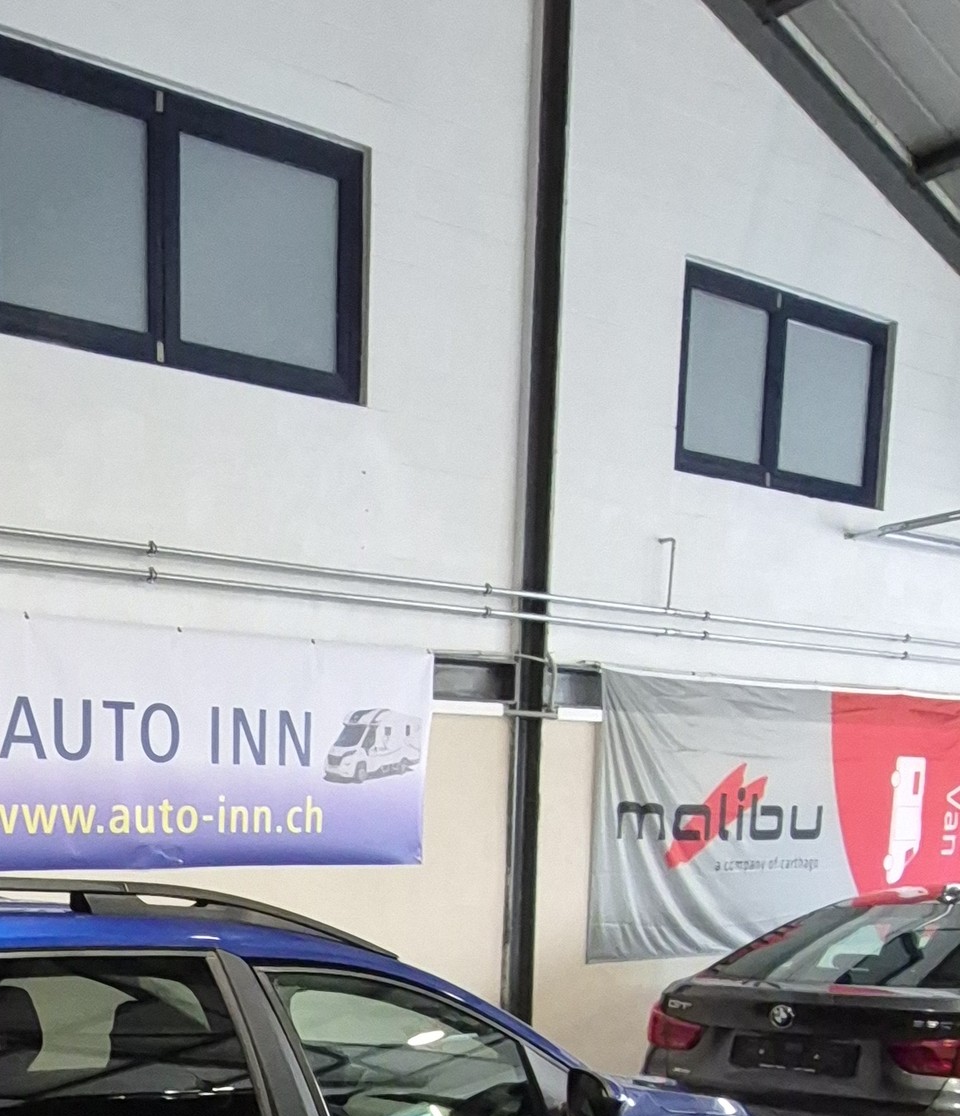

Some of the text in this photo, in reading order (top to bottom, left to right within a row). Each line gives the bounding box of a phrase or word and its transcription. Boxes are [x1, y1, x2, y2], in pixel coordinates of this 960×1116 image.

[0, 695, 313, 768] AUTO INN
[616, 786, 824, 842] malibu
[724, 859, 766, 871] company
